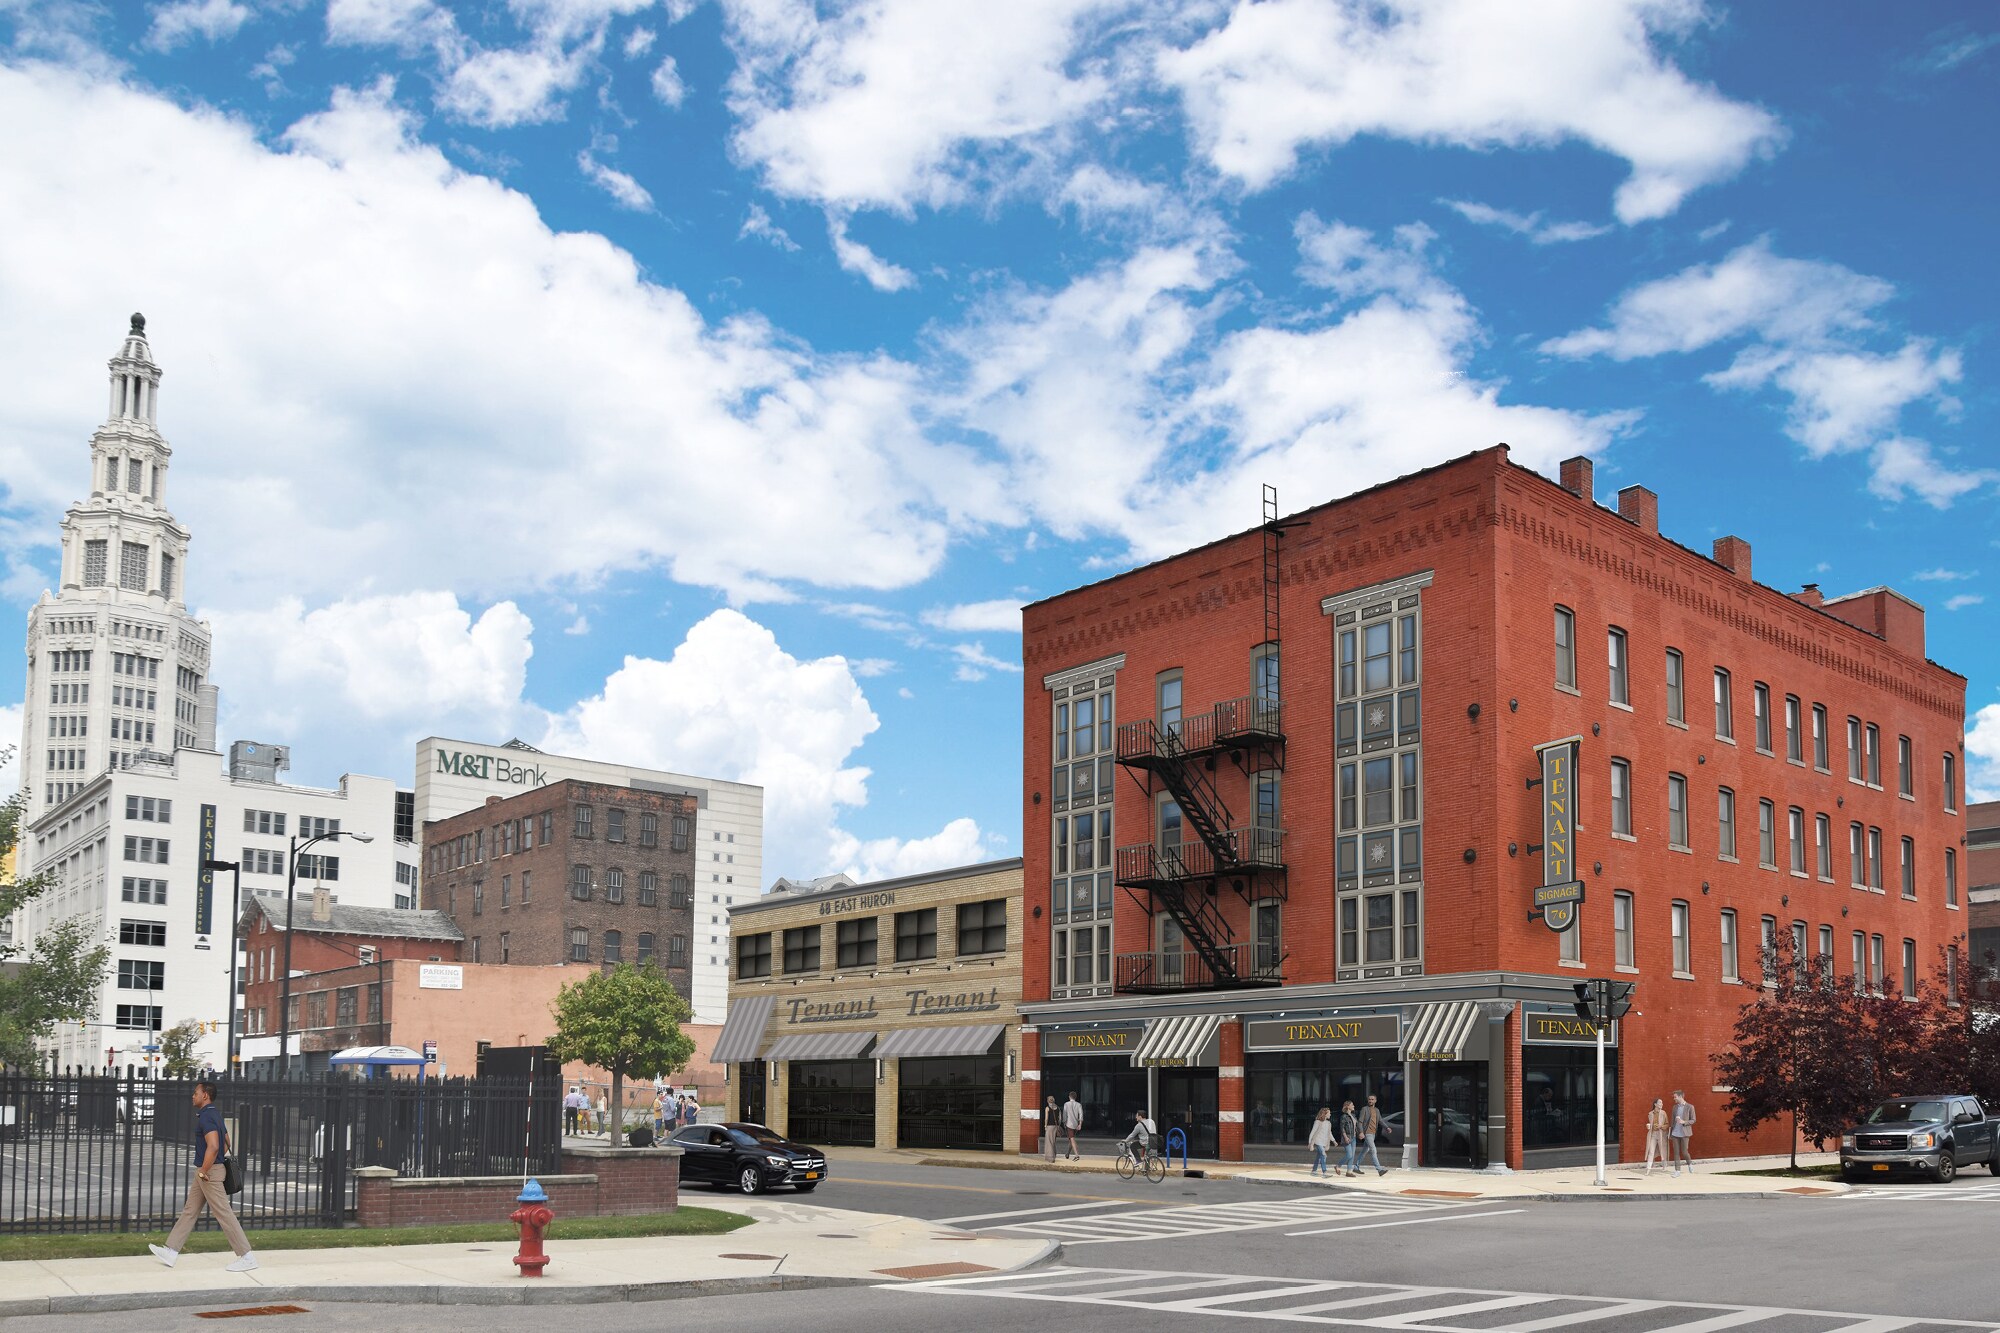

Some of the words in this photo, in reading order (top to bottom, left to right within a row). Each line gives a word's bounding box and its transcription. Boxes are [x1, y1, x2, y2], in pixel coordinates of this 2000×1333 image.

[437, 749, 494, 780] M&T
[496, 758, 547, 787] Bank
[1550, 757, 1567, 876] TENANT
[202, 808, 214, 884] LEASIG
[820, 901, 831, 915] 68
[834, 897, 857, 913] EAST
[860, 892, 895, 909] HURON
[1538, 885, 1579, 902] SIGNAGE
[1551, 909, 1567, 920] 76
[787, 995, 876, 1024] Tenant
[905, 987, 998, 1016] Tenant
[1068, 1033, 1127, 1047] TENANT
[1286, 1022, 1362, 1040] TENANT
